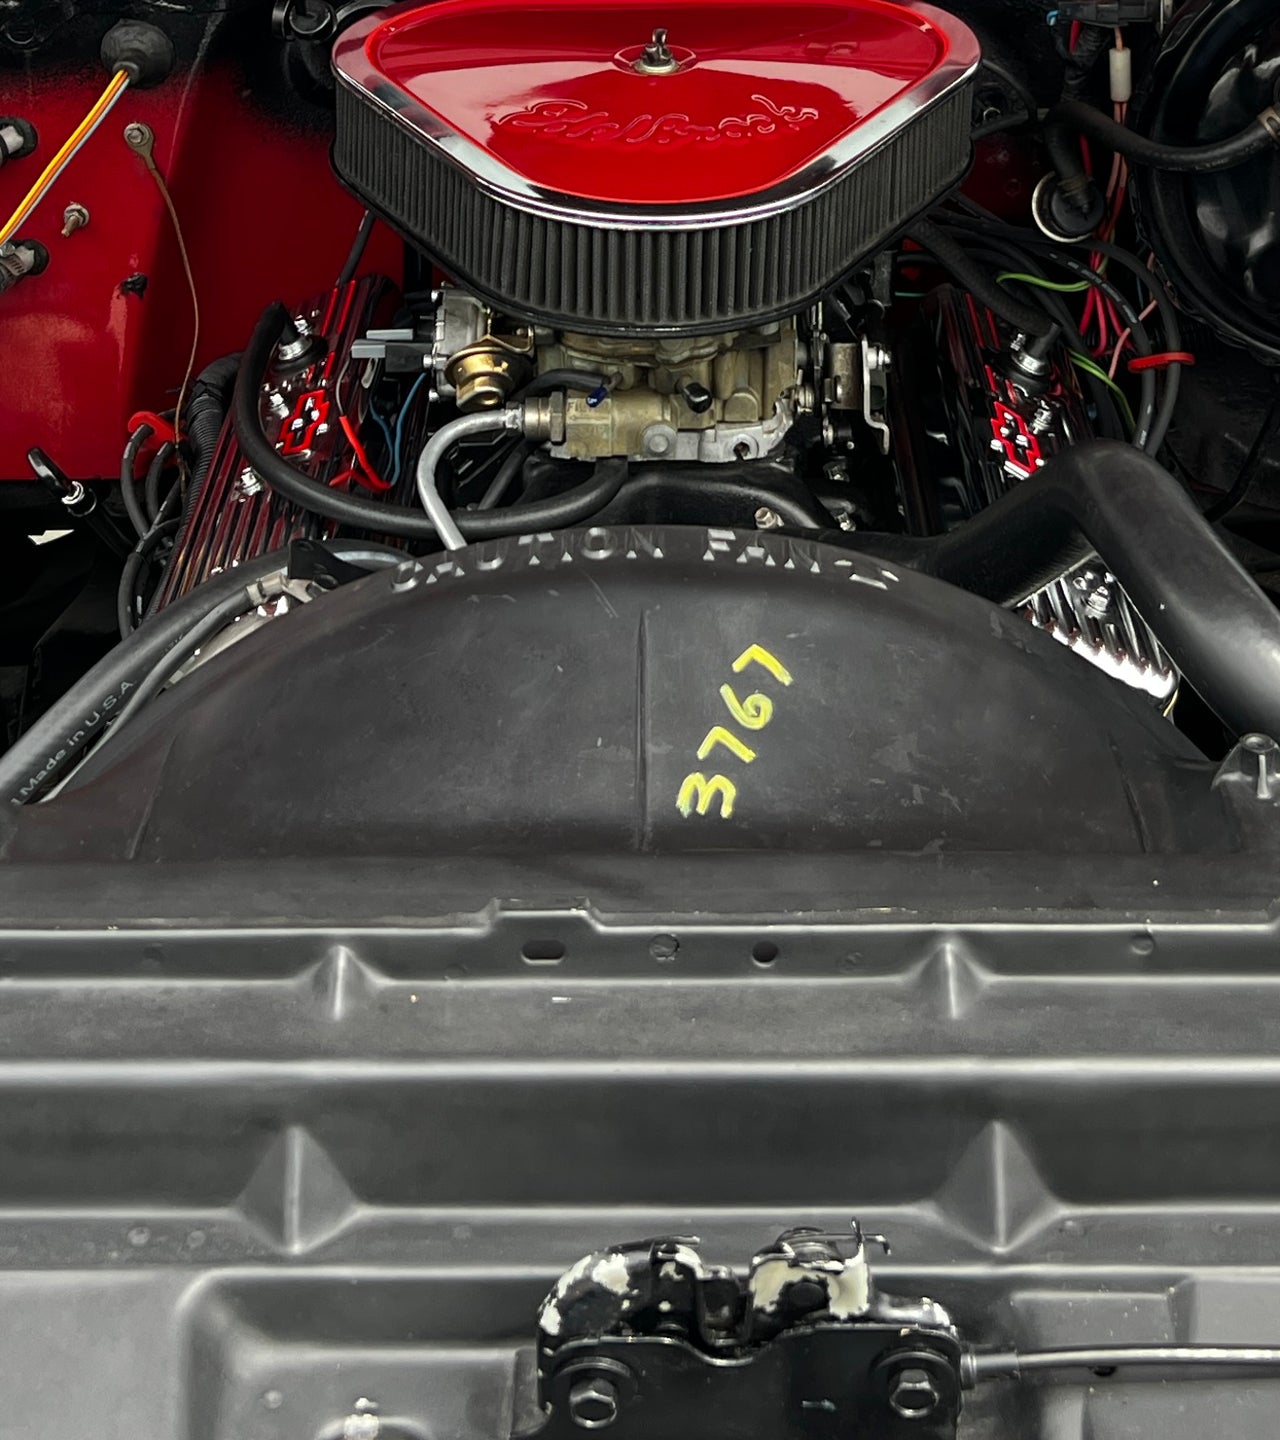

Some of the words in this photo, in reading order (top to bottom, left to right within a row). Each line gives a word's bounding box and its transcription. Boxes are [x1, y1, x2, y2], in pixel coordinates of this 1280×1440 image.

[391, 526, 665, 594] CAUTION
[701, 527, 821, 574] FAN
[20, 748, 66, 796] Made
[67, 730, 85, 747] in
[676, 643, 794, 819] 3767
